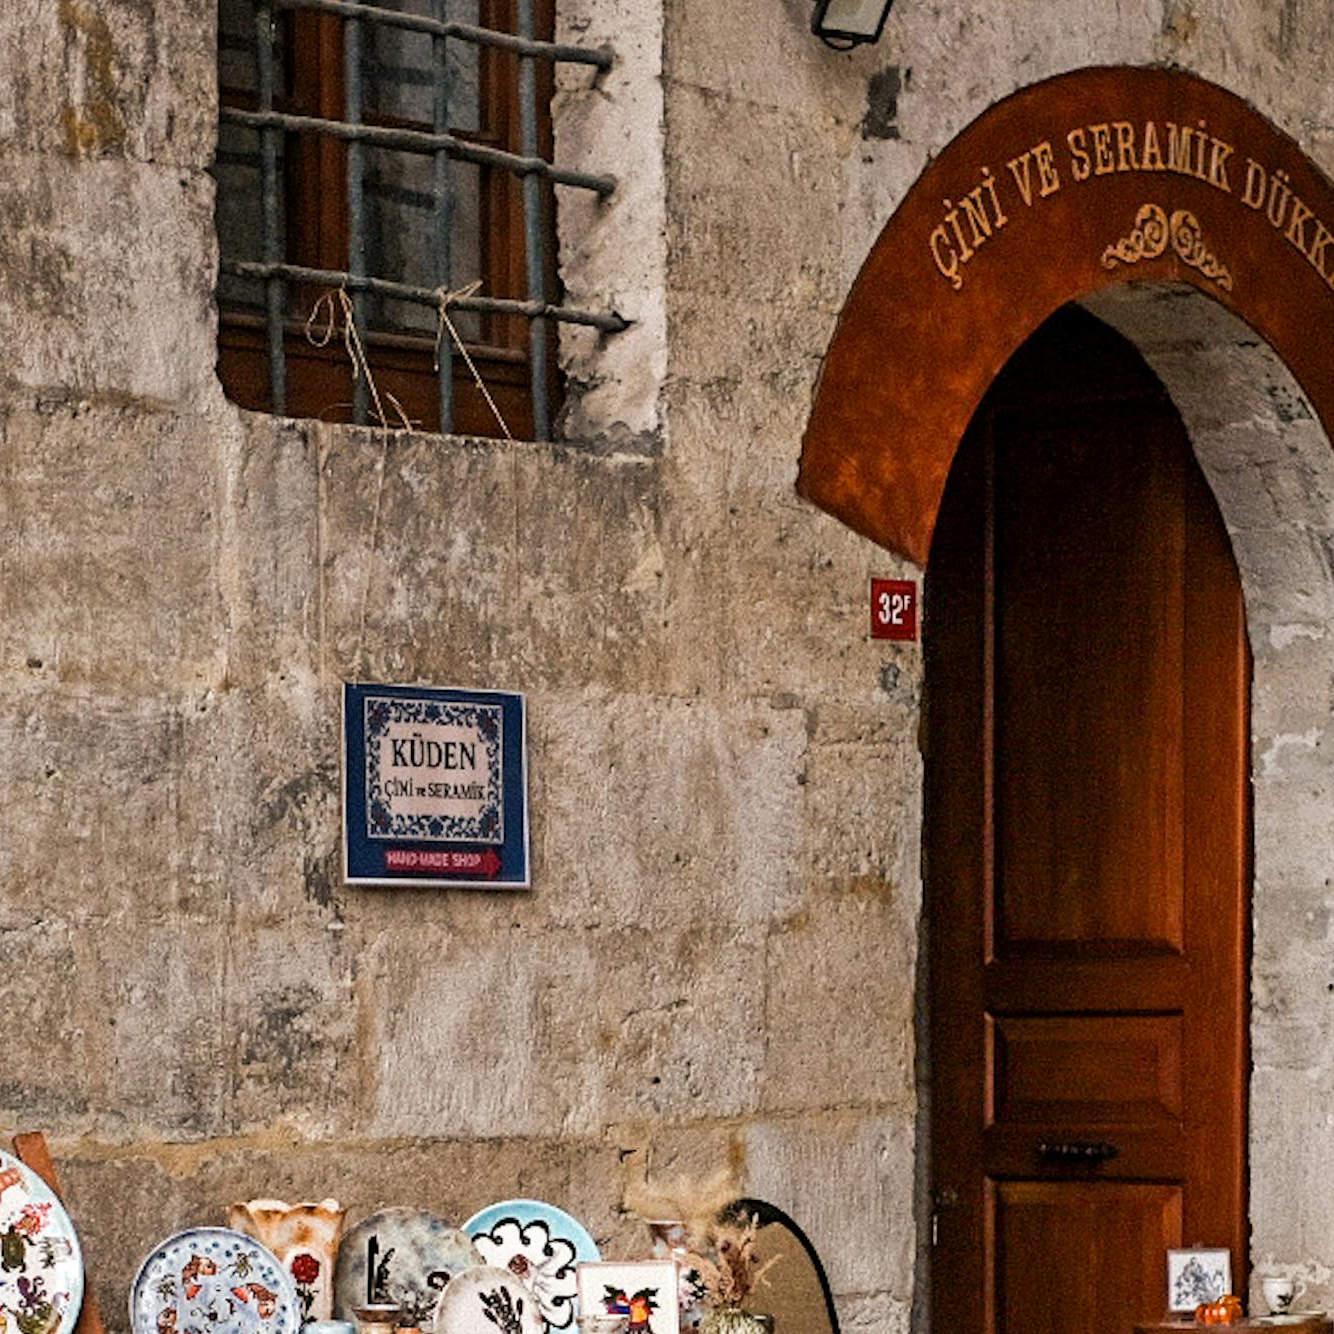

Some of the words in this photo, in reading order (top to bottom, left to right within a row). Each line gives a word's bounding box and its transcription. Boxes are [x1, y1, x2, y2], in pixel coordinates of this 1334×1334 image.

[928, 165, 1008, 291] ÇİNİ
[1008, 141, 1060, 206] VE
[1067, 119, 1233, 194] SERAMİK
[391, 732, 476, 770] KÜDEN
[384, 776, 413, 800] ÇİNİ
[428, 780, 486, 800] SERAMİK
[451, 853, 482, 867] SHOP
